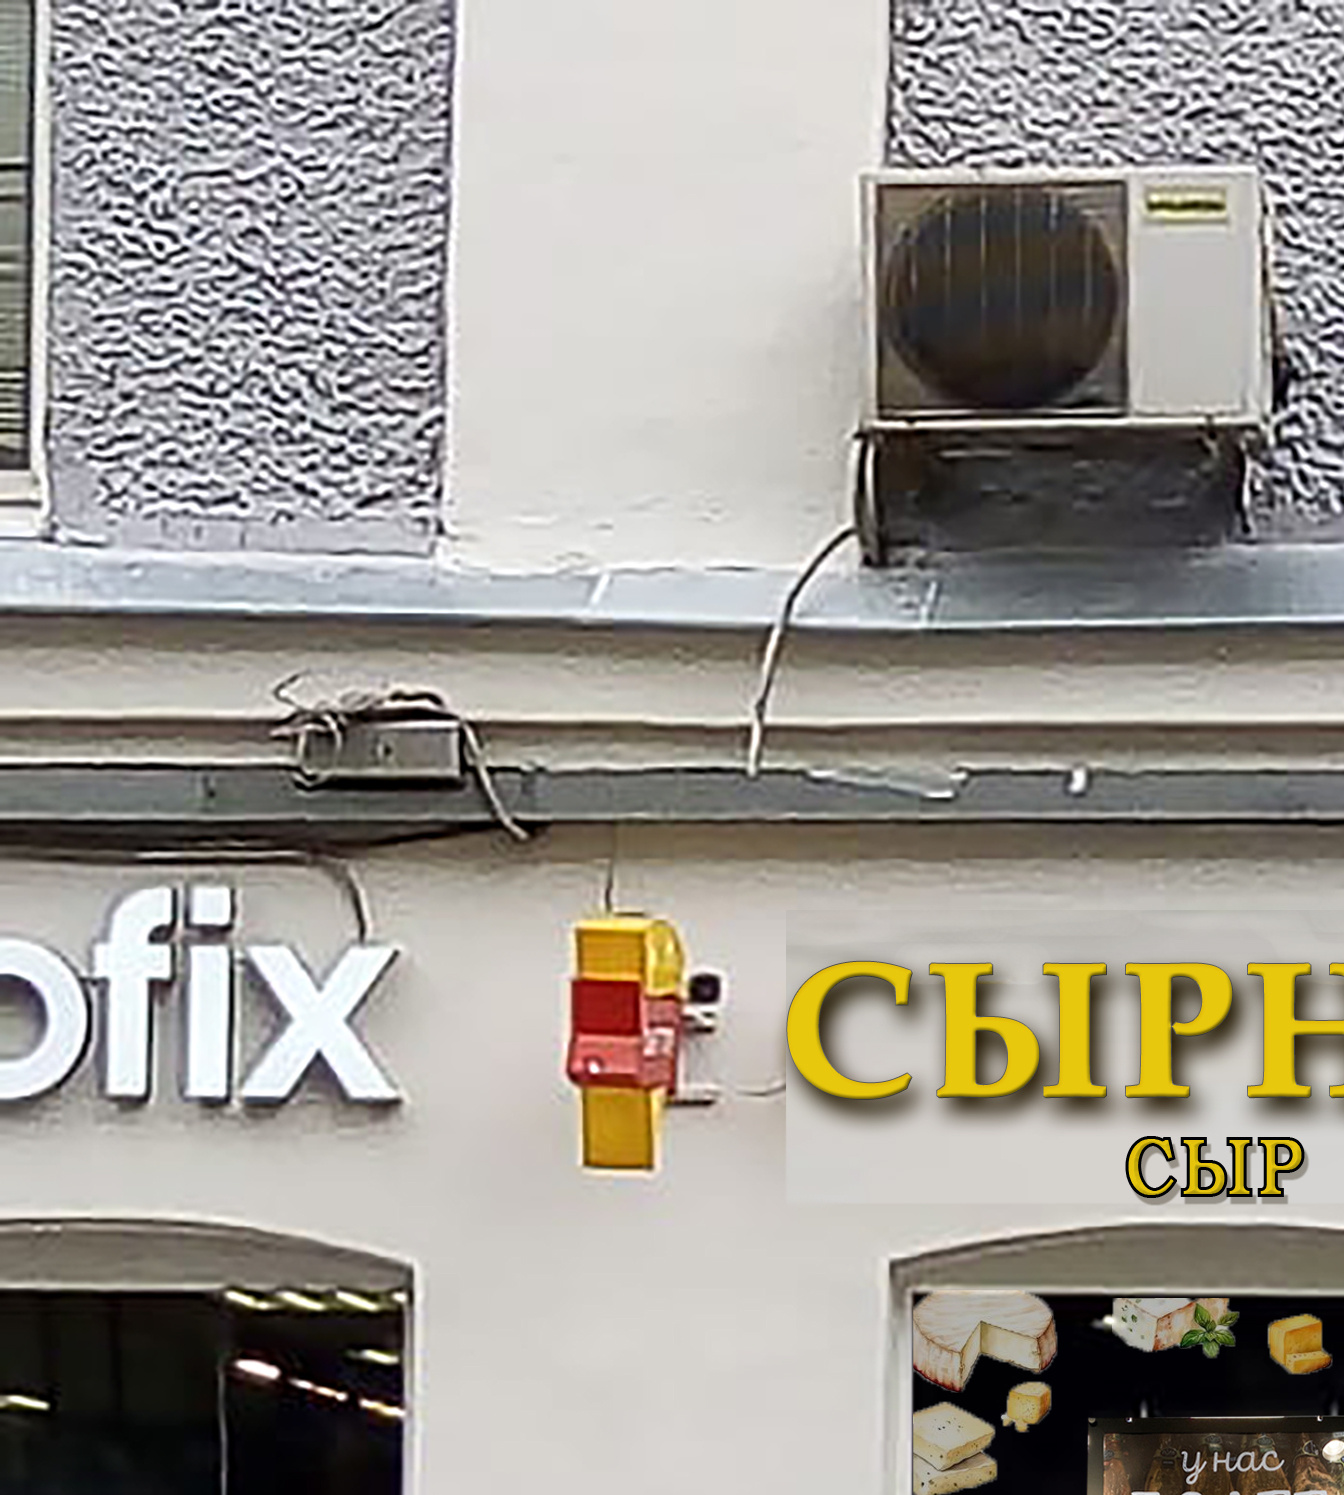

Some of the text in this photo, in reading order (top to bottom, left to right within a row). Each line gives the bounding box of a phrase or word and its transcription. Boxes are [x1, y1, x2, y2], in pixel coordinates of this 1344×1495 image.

[1126, 1136, 1305, 1198] СЫР
[1181, 1451, 1285, 1485] у нас
